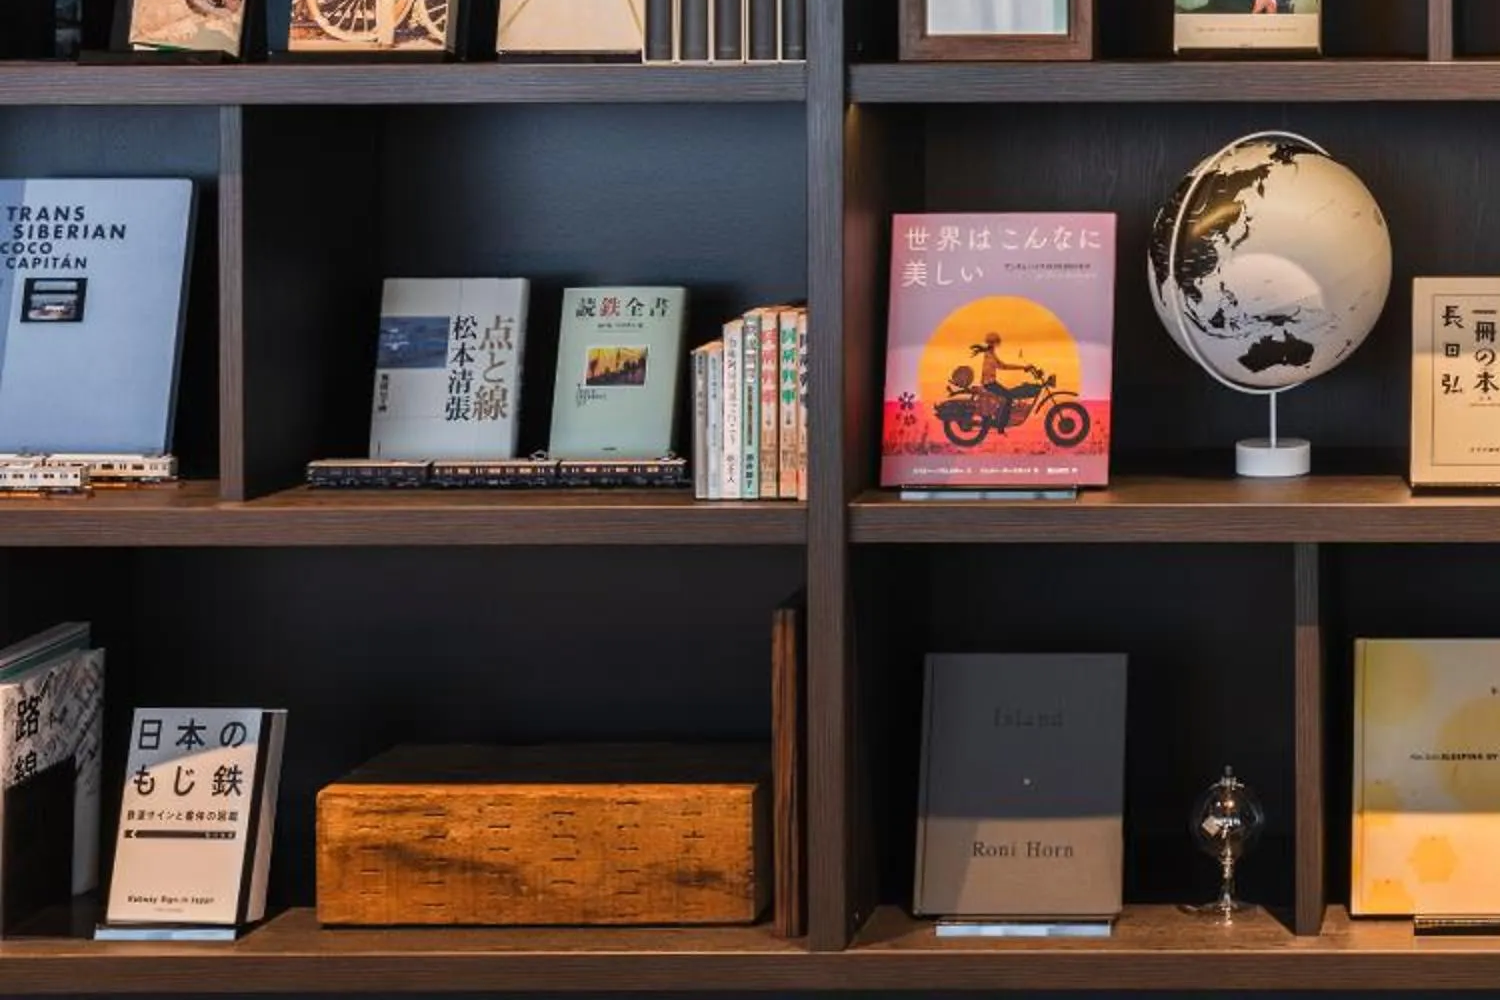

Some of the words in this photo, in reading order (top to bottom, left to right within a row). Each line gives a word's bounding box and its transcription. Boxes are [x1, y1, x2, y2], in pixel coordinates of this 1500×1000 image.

[6, 205, 86, 222] TRANS
[12, 223, 127, 241] SIBERIAN
[905, 226, 1102, 252] 世界はこんなに
[0, 241, 53, 255] COCO
[5, 253, 89, 270] CAPITÁN
[902, 261, 985, 287] 美しい
[576, 296, 671, 318] 読鉄全書
[1441, 304, 1465, 395] 長田弘
[1472, 308, 1500, 393] 一冊の本
[444, 314, 478, 421] 松本清張
[473, 314, 515, 421] 点と線
[138, 718, 247, 750] 日本の
[133, 764, 243, 797] もじ鉄
[972, 841, 1016, 857] Roni
[1026, 841, 1074, 858] Horn
